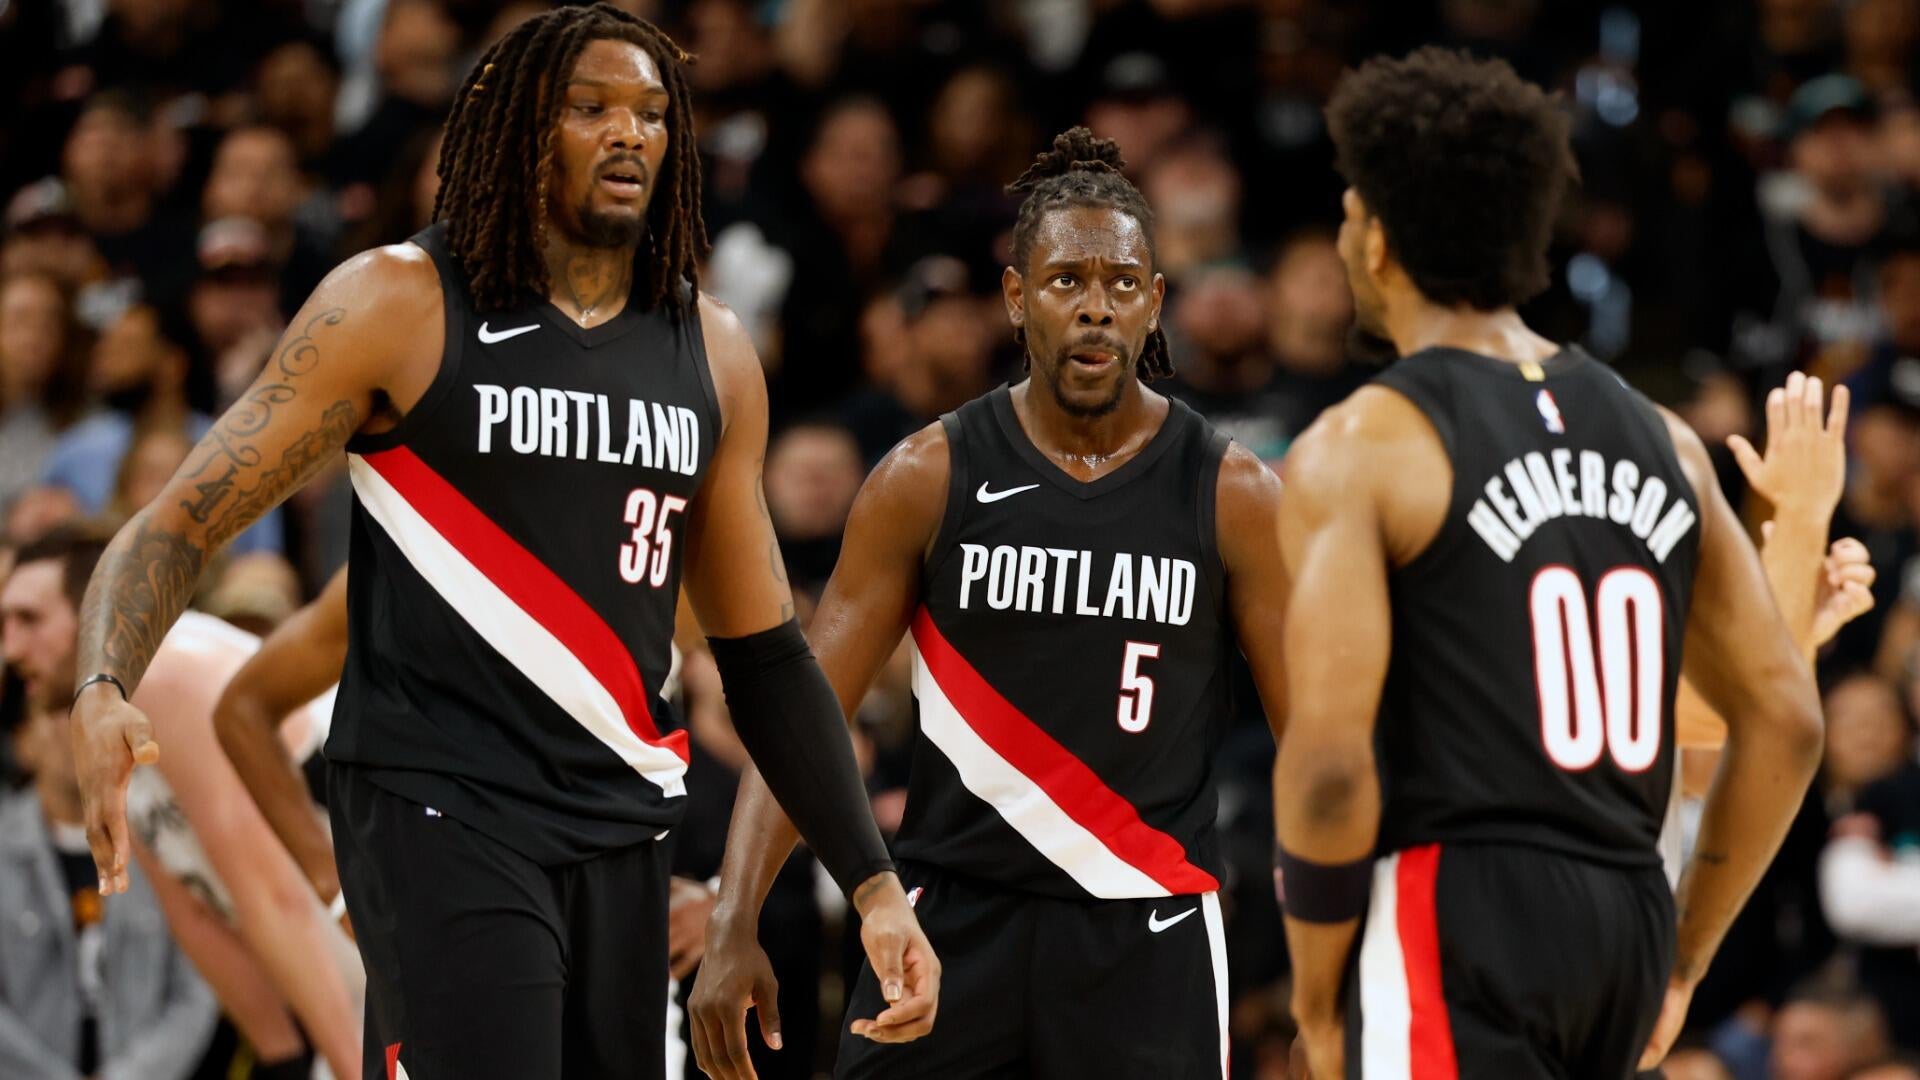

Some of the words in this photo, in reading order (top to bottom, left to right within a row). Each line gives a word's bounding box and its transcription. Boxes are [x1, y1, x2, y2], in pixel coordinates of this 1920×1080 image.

[472, 384, 699, 476] PORTLAND
[618, 487, 688, 588] 35
[1466, 448, 1696, 563] HENDERSON
[960, 543, 1197, 626] PORTLAND
[1116, 640, 1161, 734] 5
[1529, 564, 1664, 773] 00
